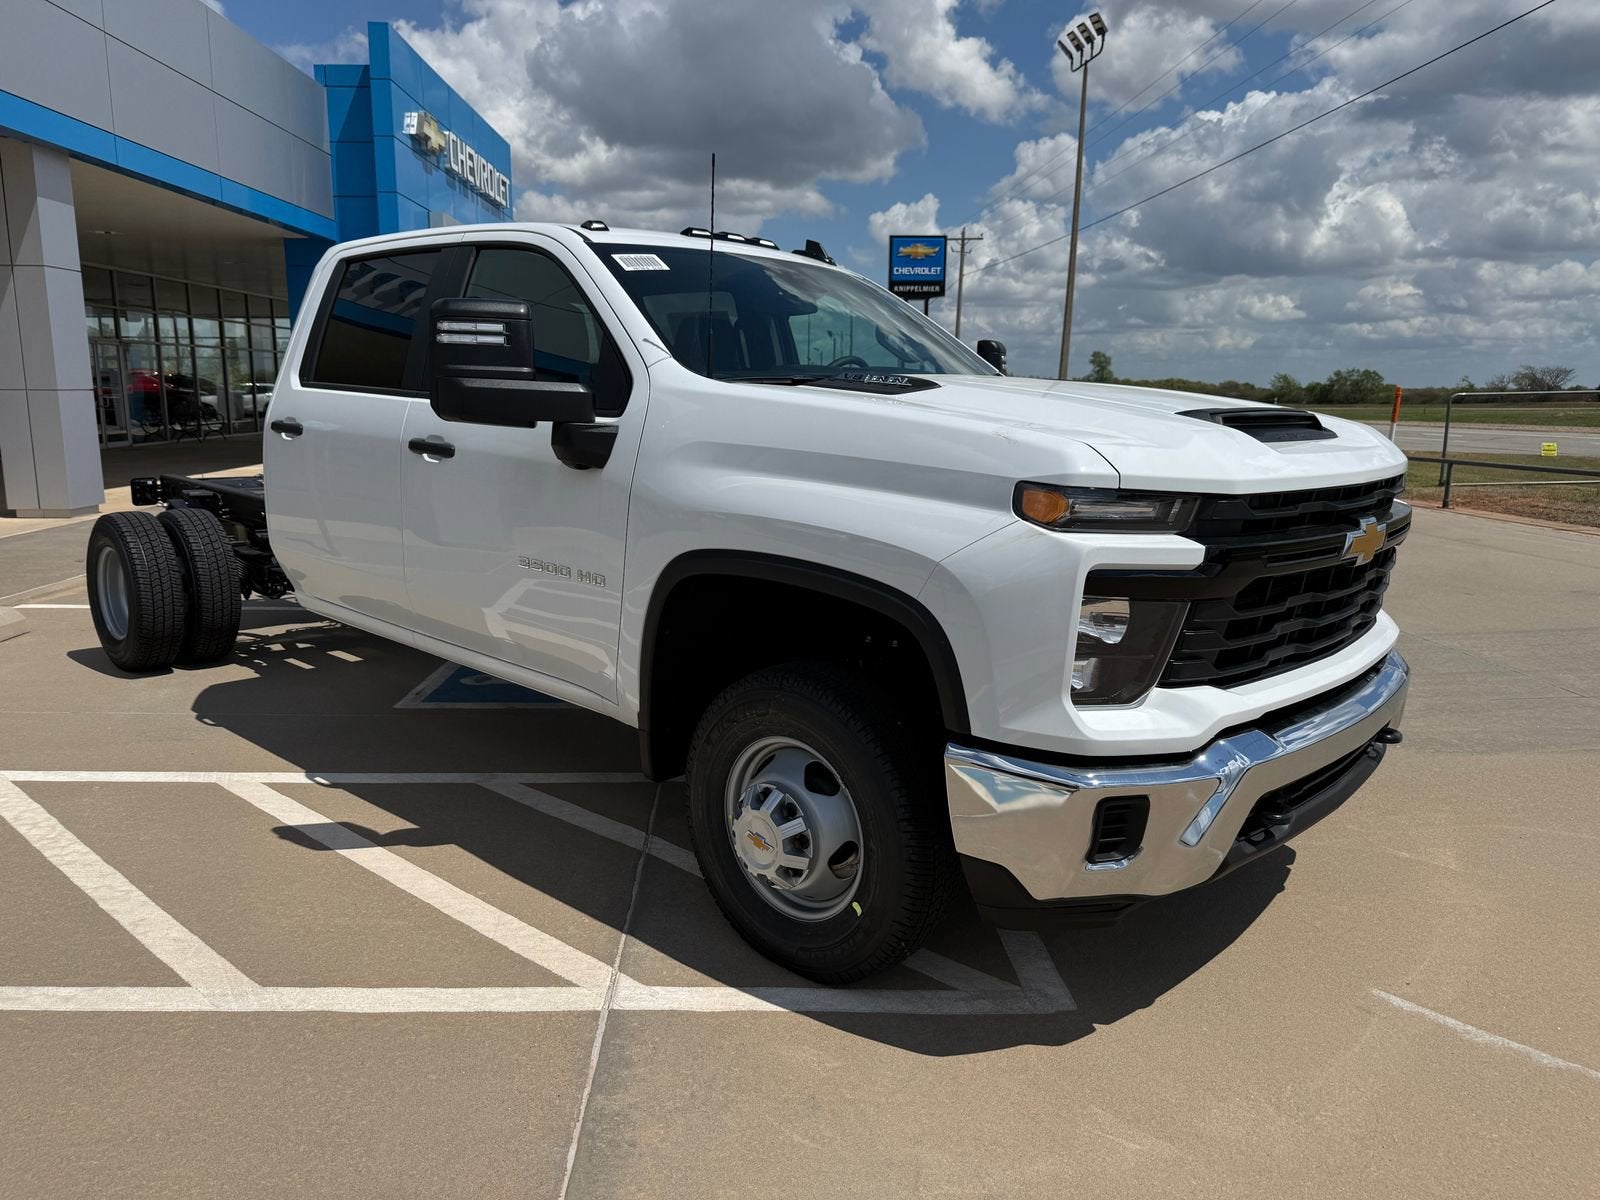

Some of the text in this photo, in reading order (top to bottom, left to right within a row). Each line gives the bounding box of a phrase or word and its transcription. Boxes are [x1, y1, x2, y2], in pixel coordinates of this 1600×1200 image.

[445, 131, 510, 209] CHEVROLET
[893, 266, 941, 275] CHEVROLET
[518, 555, 606, 587] 3500 HD
